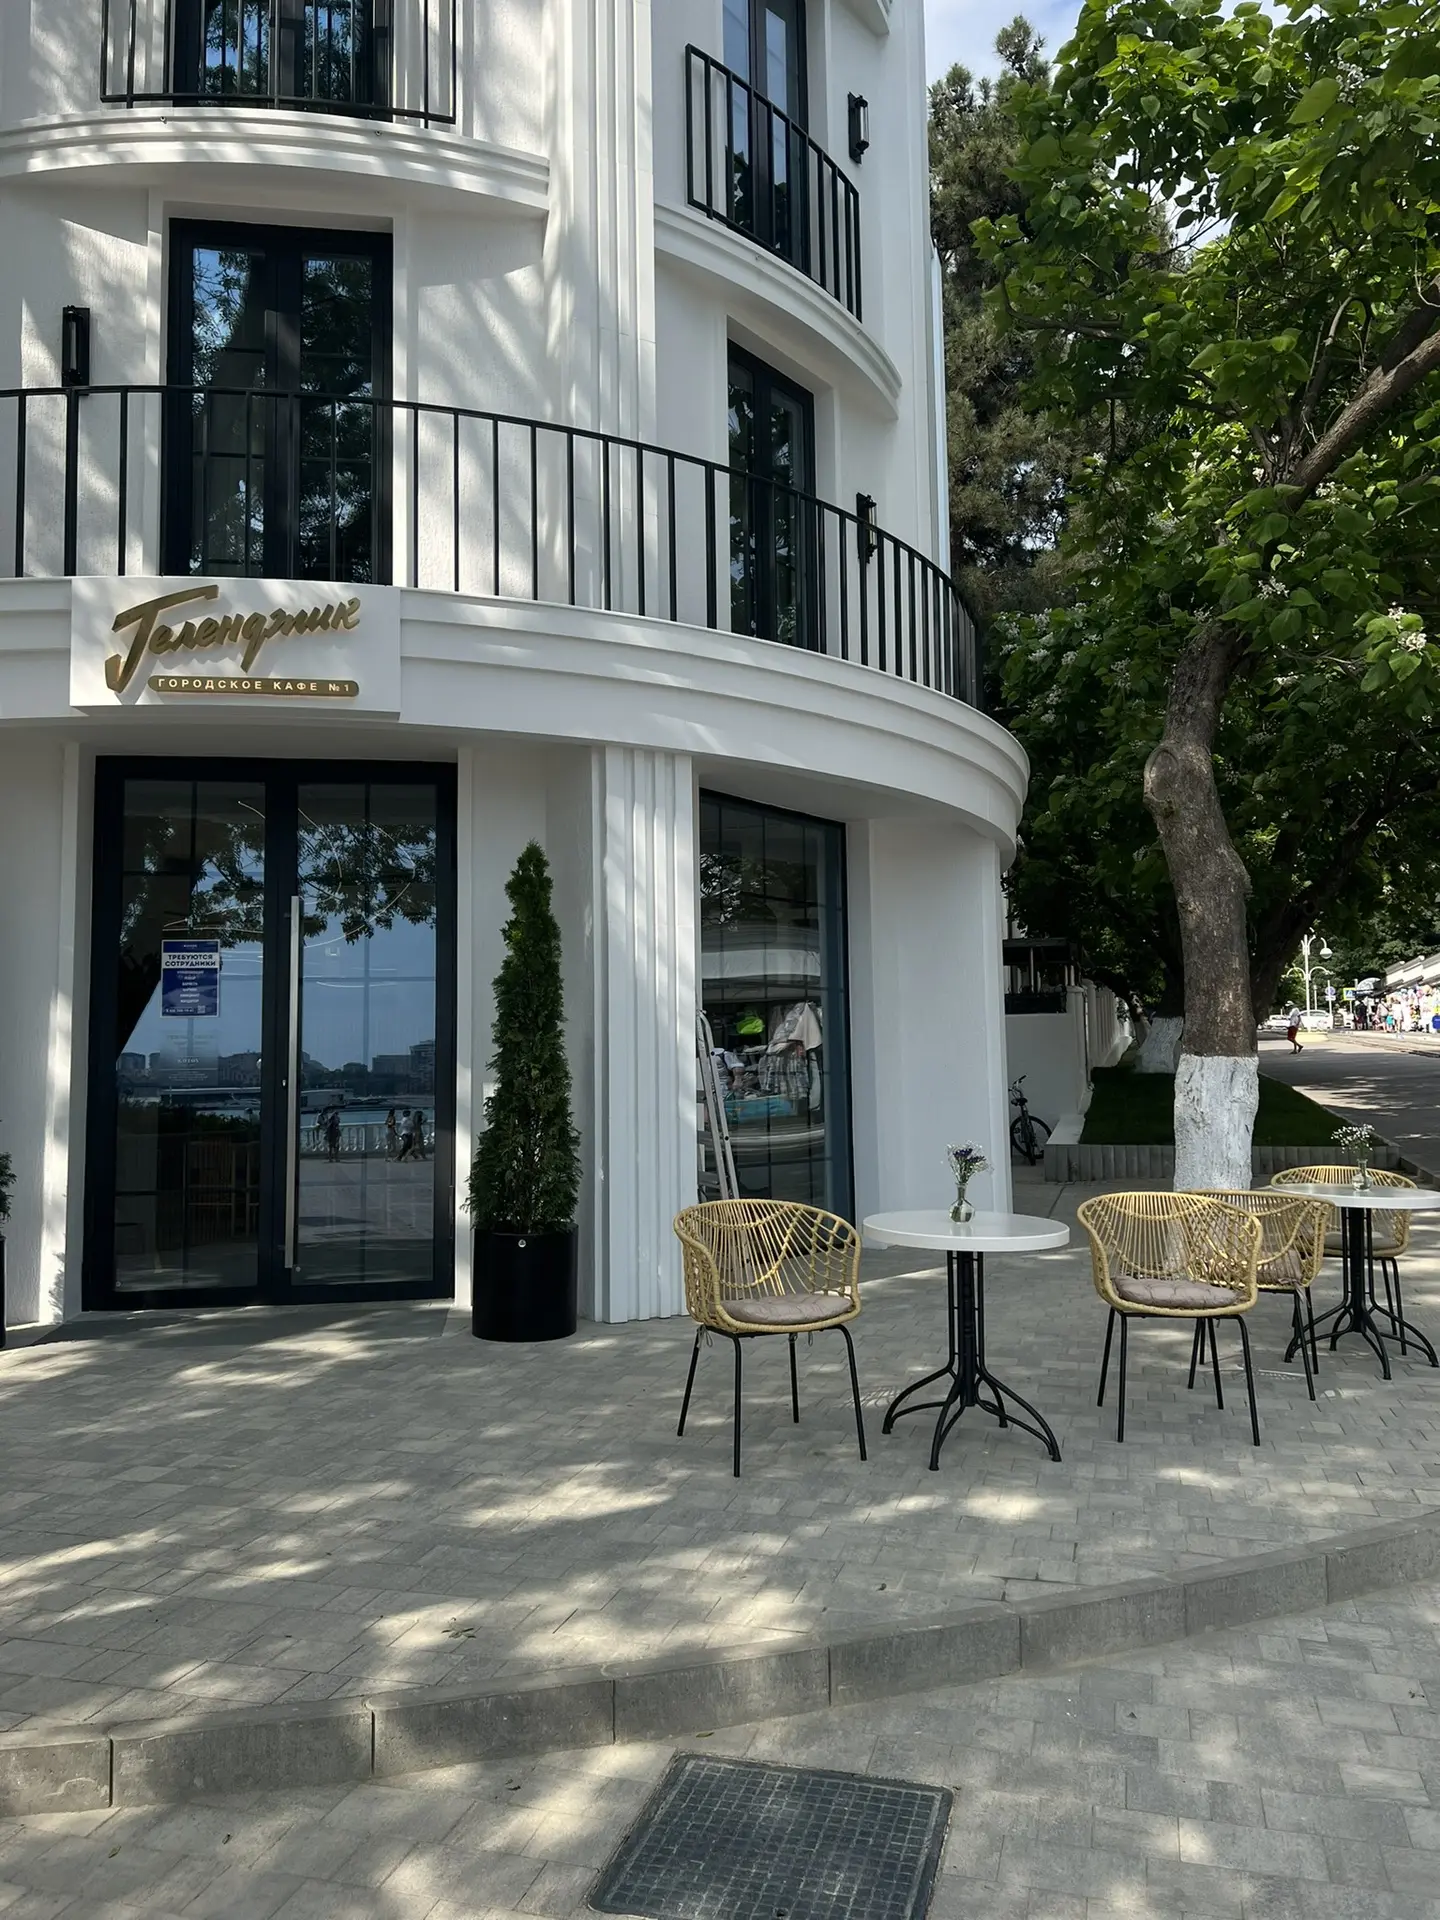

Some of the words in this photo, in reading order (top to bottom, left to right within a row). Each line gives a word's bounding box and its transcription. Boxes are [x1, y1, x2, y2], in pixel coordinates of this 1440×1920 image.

[104, 584, 361, 694] Геленджик
[158, 678, 262, 690] ГОРОДСКОЕ
[273, 681, 318, 692] КАФЕ
